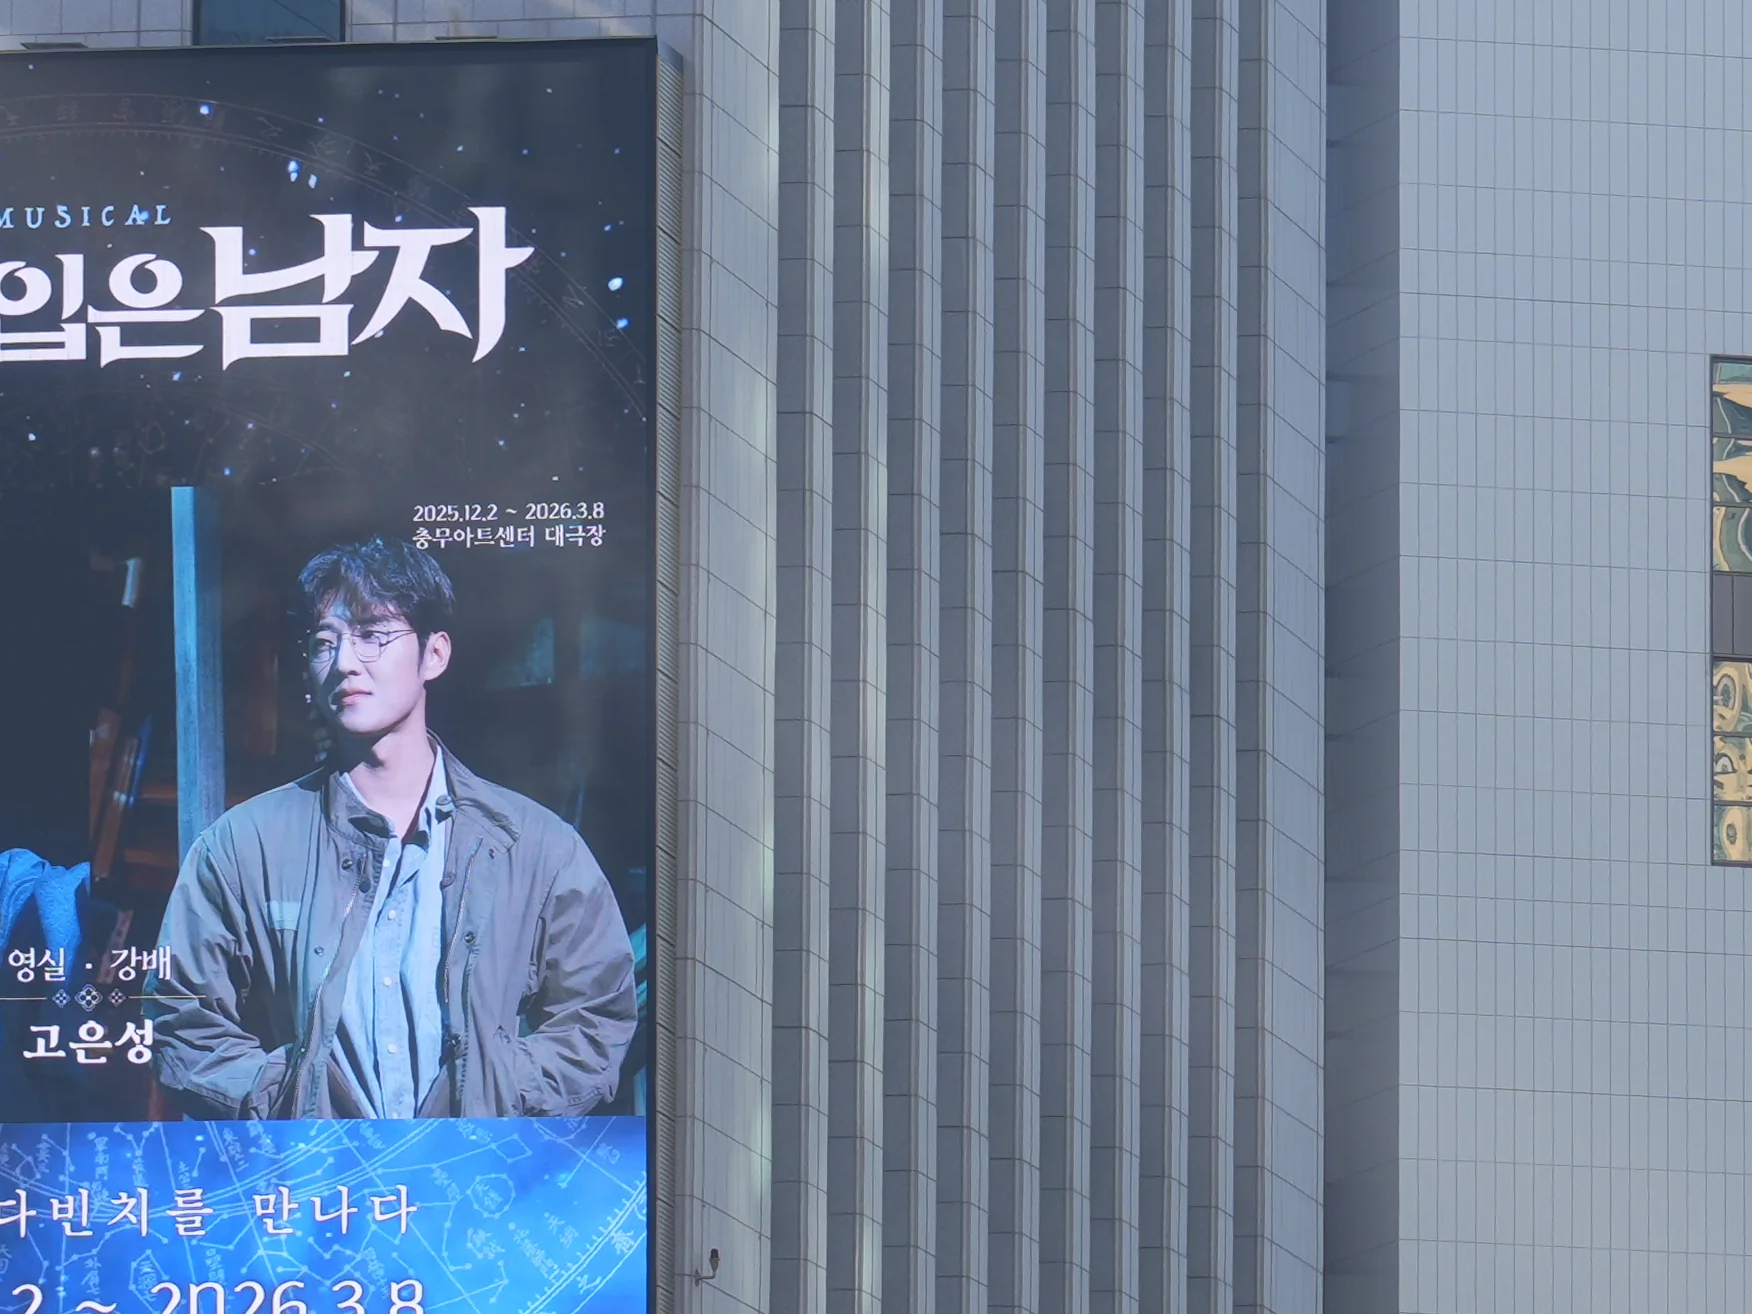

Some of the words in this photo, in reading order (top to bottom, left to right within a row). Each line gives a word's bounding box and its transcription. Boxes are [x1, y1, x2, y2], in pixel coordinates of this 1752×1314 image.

[411, 503, 499, 523] 2025.12.2
[524, 501, 606, 521] 2026.3.8
[411, 526, 536, 550] 충무아트센터
[544, 524, 607, 548] 대극장
[7, 946, 66, 983] 영실
[109, 944, 172, 981] 강배
[22, 1018, 155, 1065] 고은성
[253, 1184, 419, 1236] 만나다
